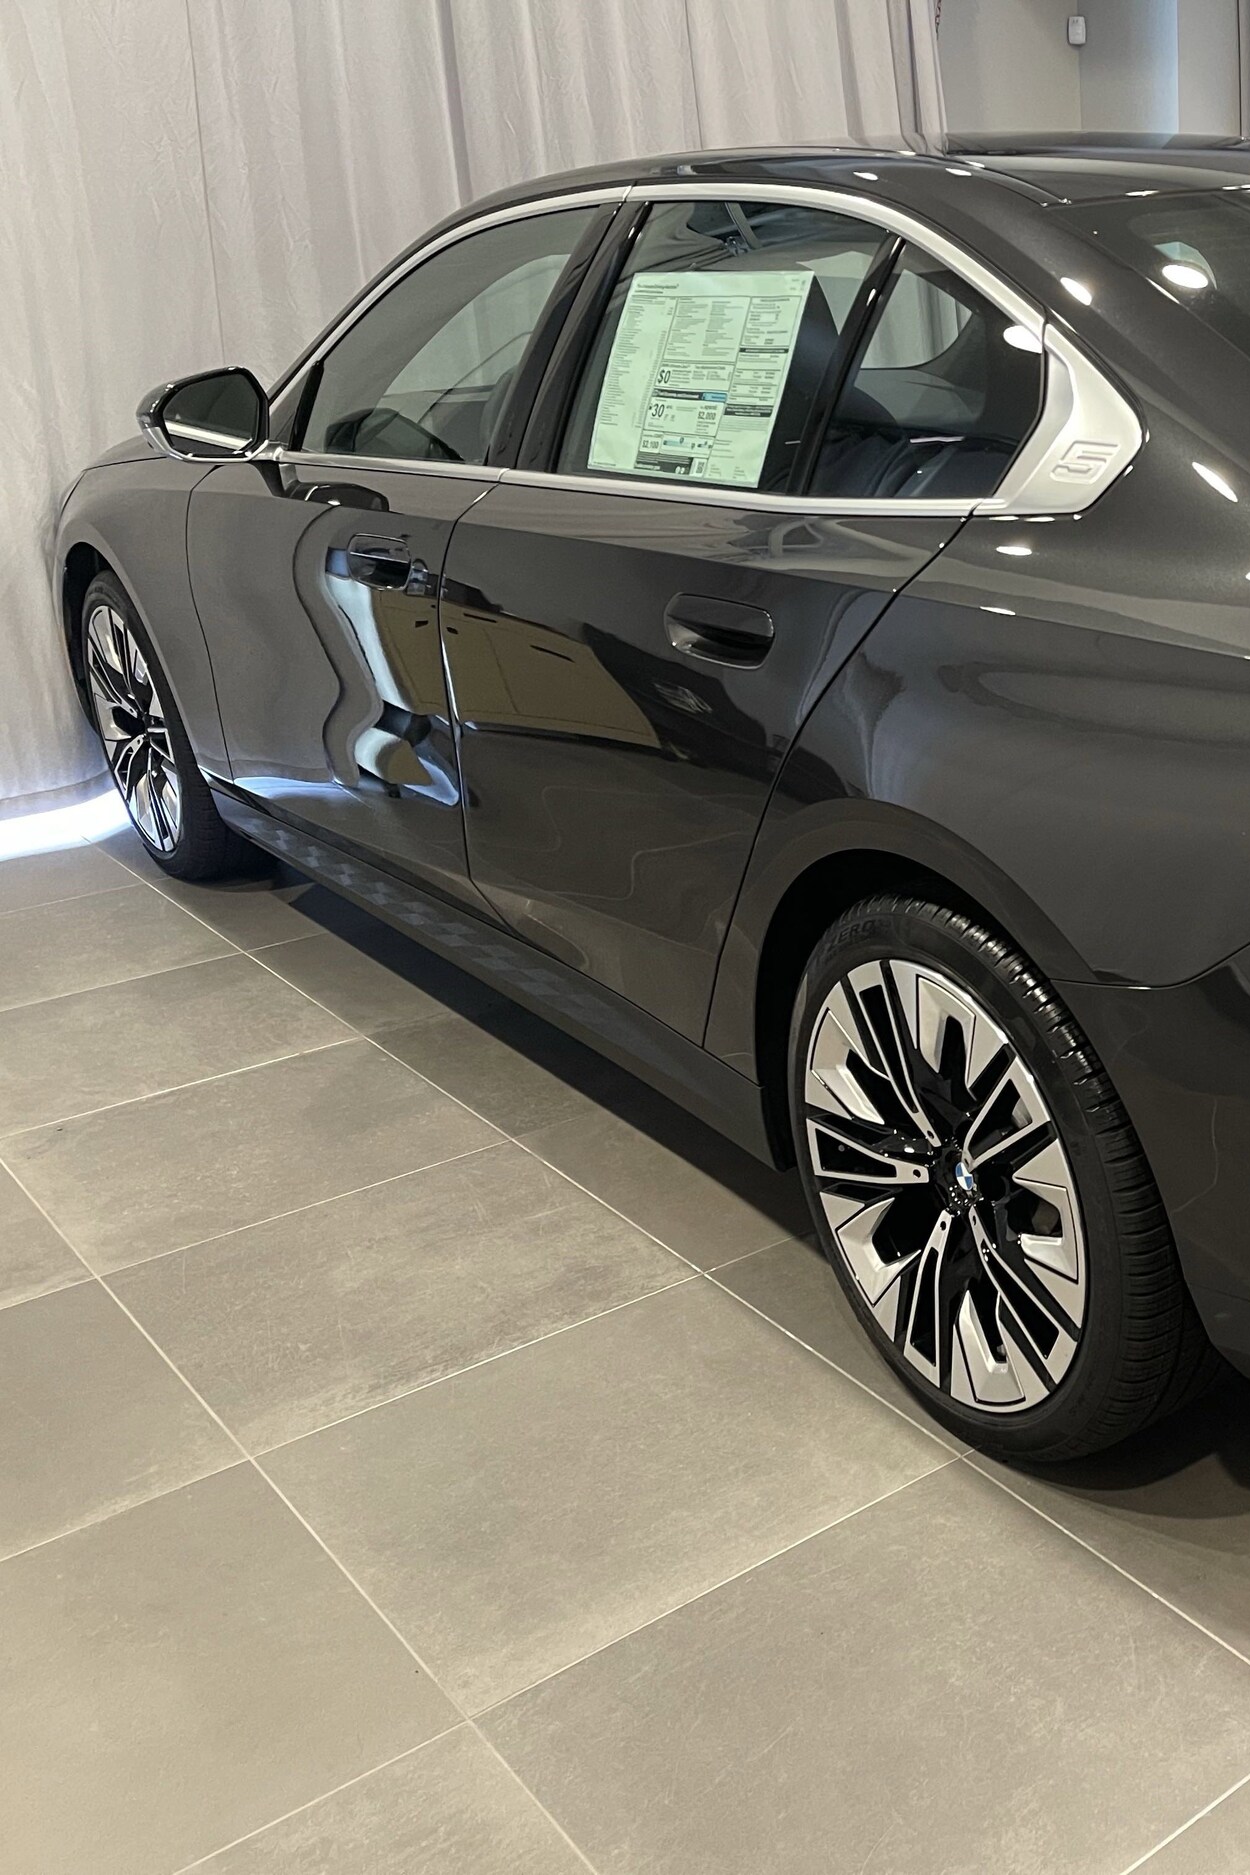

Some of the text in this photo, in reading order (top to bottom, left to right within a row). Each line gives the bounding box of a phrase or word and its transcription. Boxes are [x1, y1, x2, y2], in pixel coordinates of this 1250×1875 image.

[657, 368, 671, 384] $0
[651, 403, 665, 418] 30
[1050, 440, 1118, 484] 5
